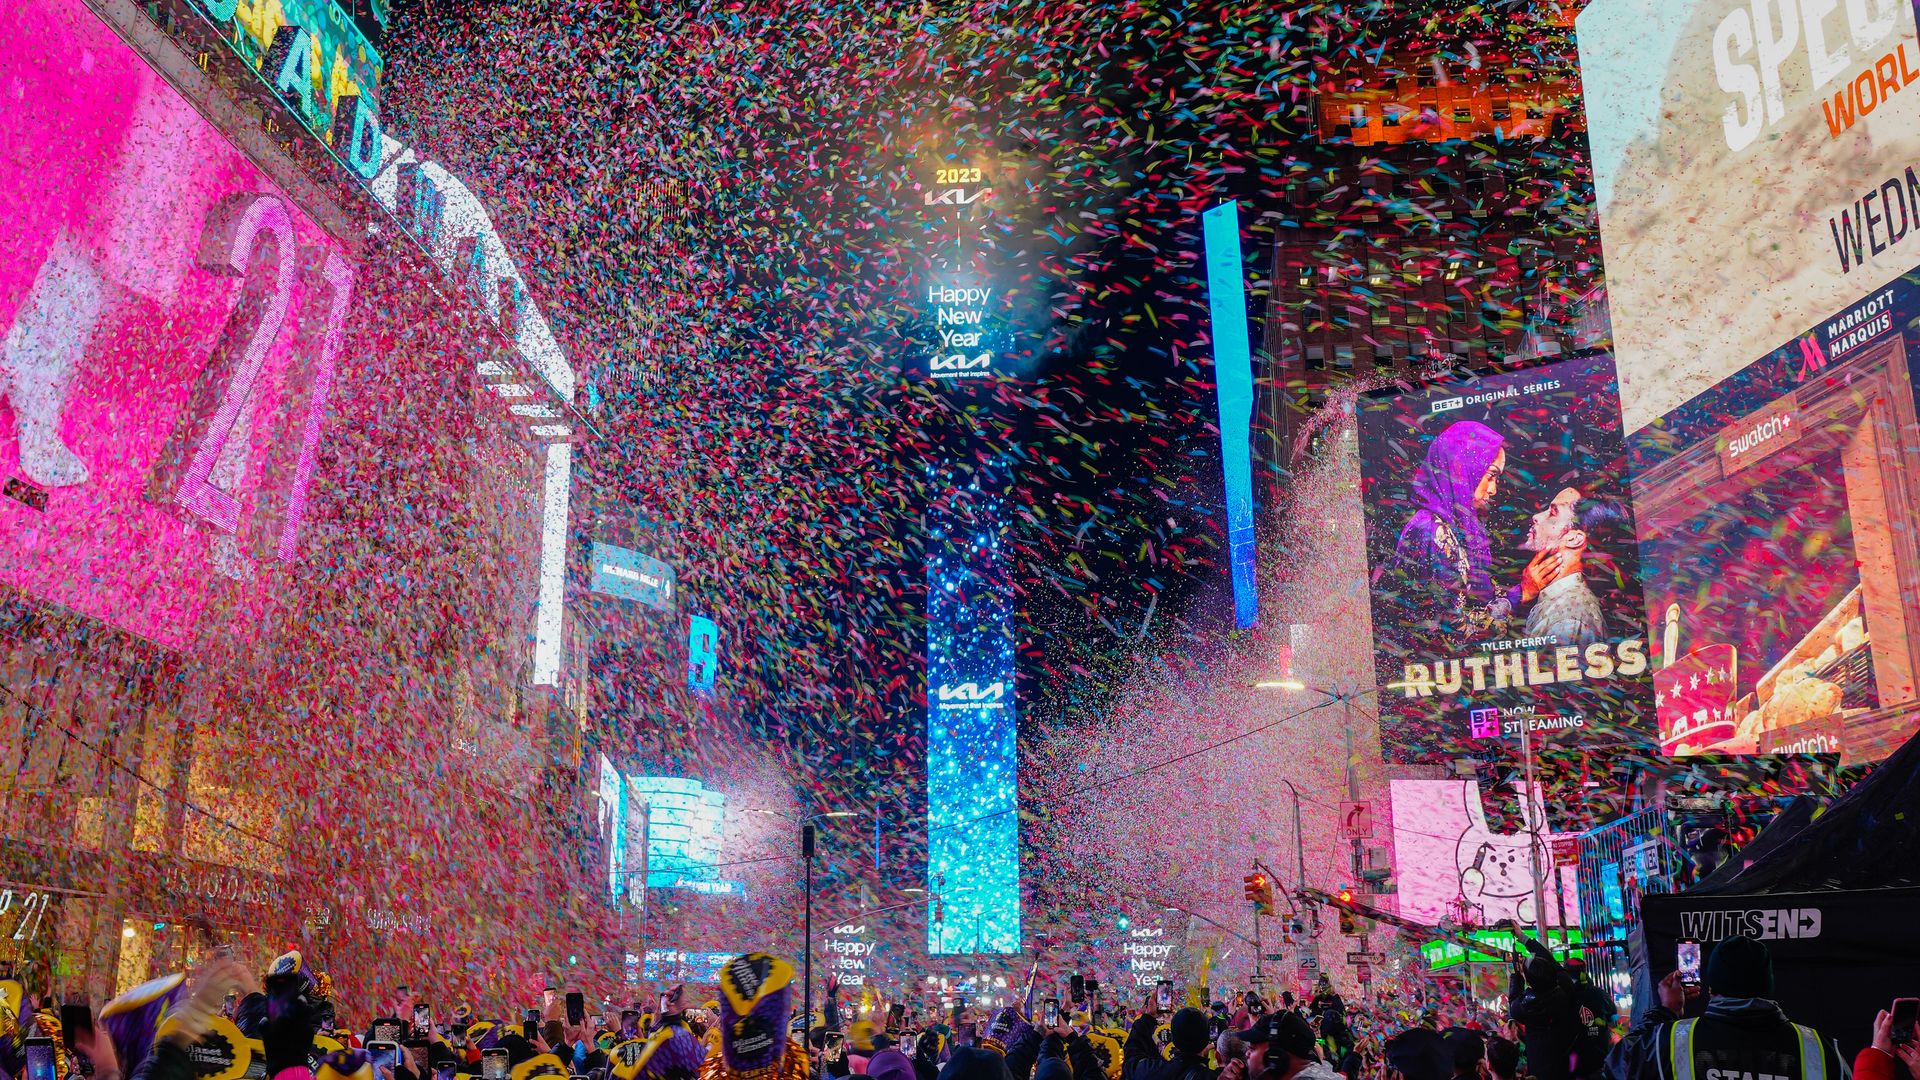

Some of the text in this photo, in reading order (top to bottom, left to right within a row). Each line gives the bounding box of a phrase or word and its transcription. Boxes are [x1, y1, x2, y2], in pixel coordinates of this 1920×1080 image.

[1713, 0, 1914, 152] SPE
[1822, 32, 1920, 139] WORL
[936, 168, 981, 183] 2023
[929, 286, 991, 306] Happy
[938, 308, 982, 325] New
[1828, 290, 1894, 338] MARRIOTT
[939, 329, 982, 347] Year
[1831, 314, 1890, 357] MARQUIS
[930, 354, 990, 370] KIA
[1433, 380, 1560, 411] BET+ ORIGINAL SERIES
[1480, 635, 1557, 652] TYLER PERRY'S
[1404, 640, 1647, 697] RUTHLESS
[938, 682, 1004, 700] KIA
[1503, 705, 1536, 718] NOW
[1503, 715, 1583, 733] STEAMING
[1346, 828, 1367, 836] ONLY
[13, 891, 49, 941] 21
[1680, 908, 1821, 942] WITSEND
[824, 939, 875, 956] Happy
[1123, 942, 1171, 957] Happy
[1131, 958, 1165, 970] New
[1301, 958, 1317, 968] 25
[832, 972, 866, 985] Year
